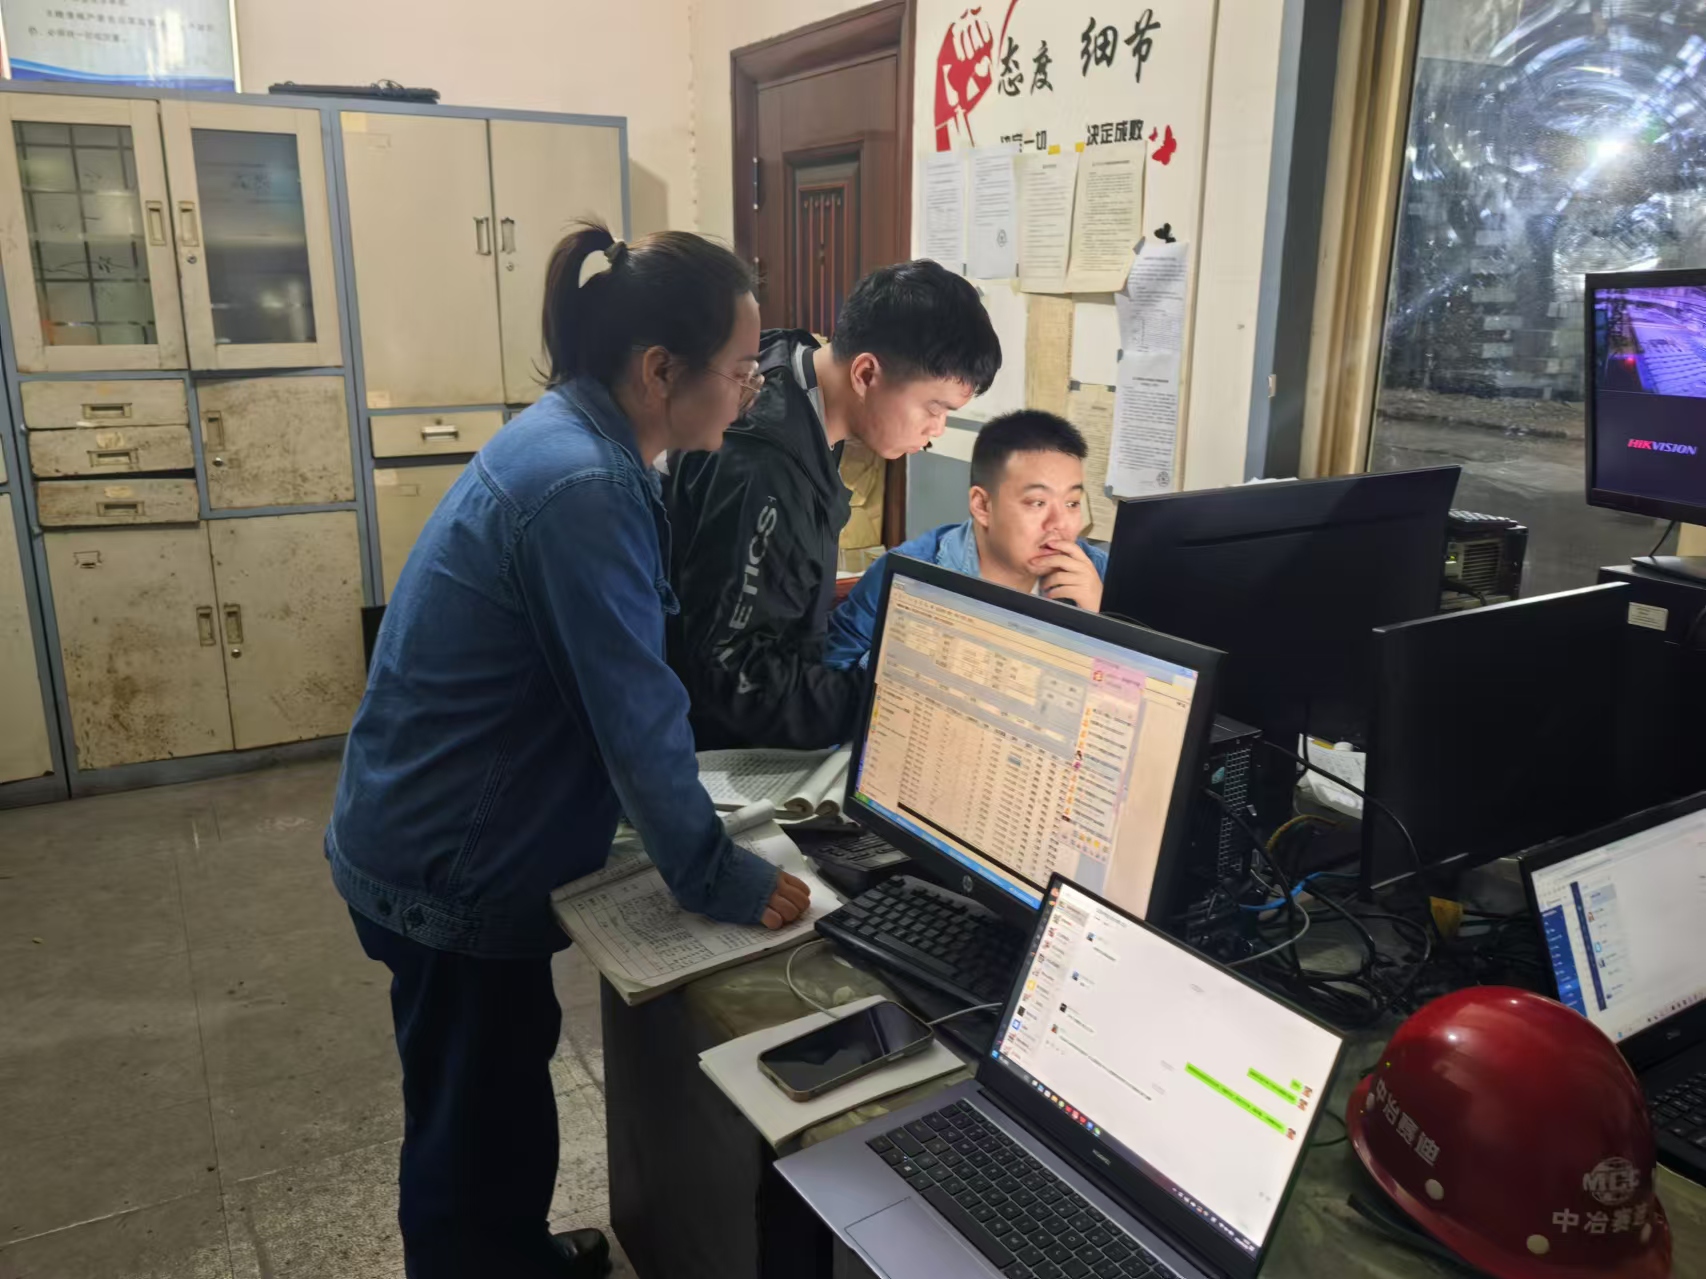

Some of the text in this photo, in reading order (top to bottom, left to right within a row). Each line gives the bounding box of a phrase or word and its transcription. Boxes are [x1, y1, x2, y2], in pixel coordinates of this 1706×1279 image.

[997, 36, 1054, 97] 态度
[1080, 8, 1161, 83] 细节
[1086, 118, 1144, 147] 决定成败
[1627, 438, 1698, 455] HIKVISION
[718, 505, 778, 694] AETICS
